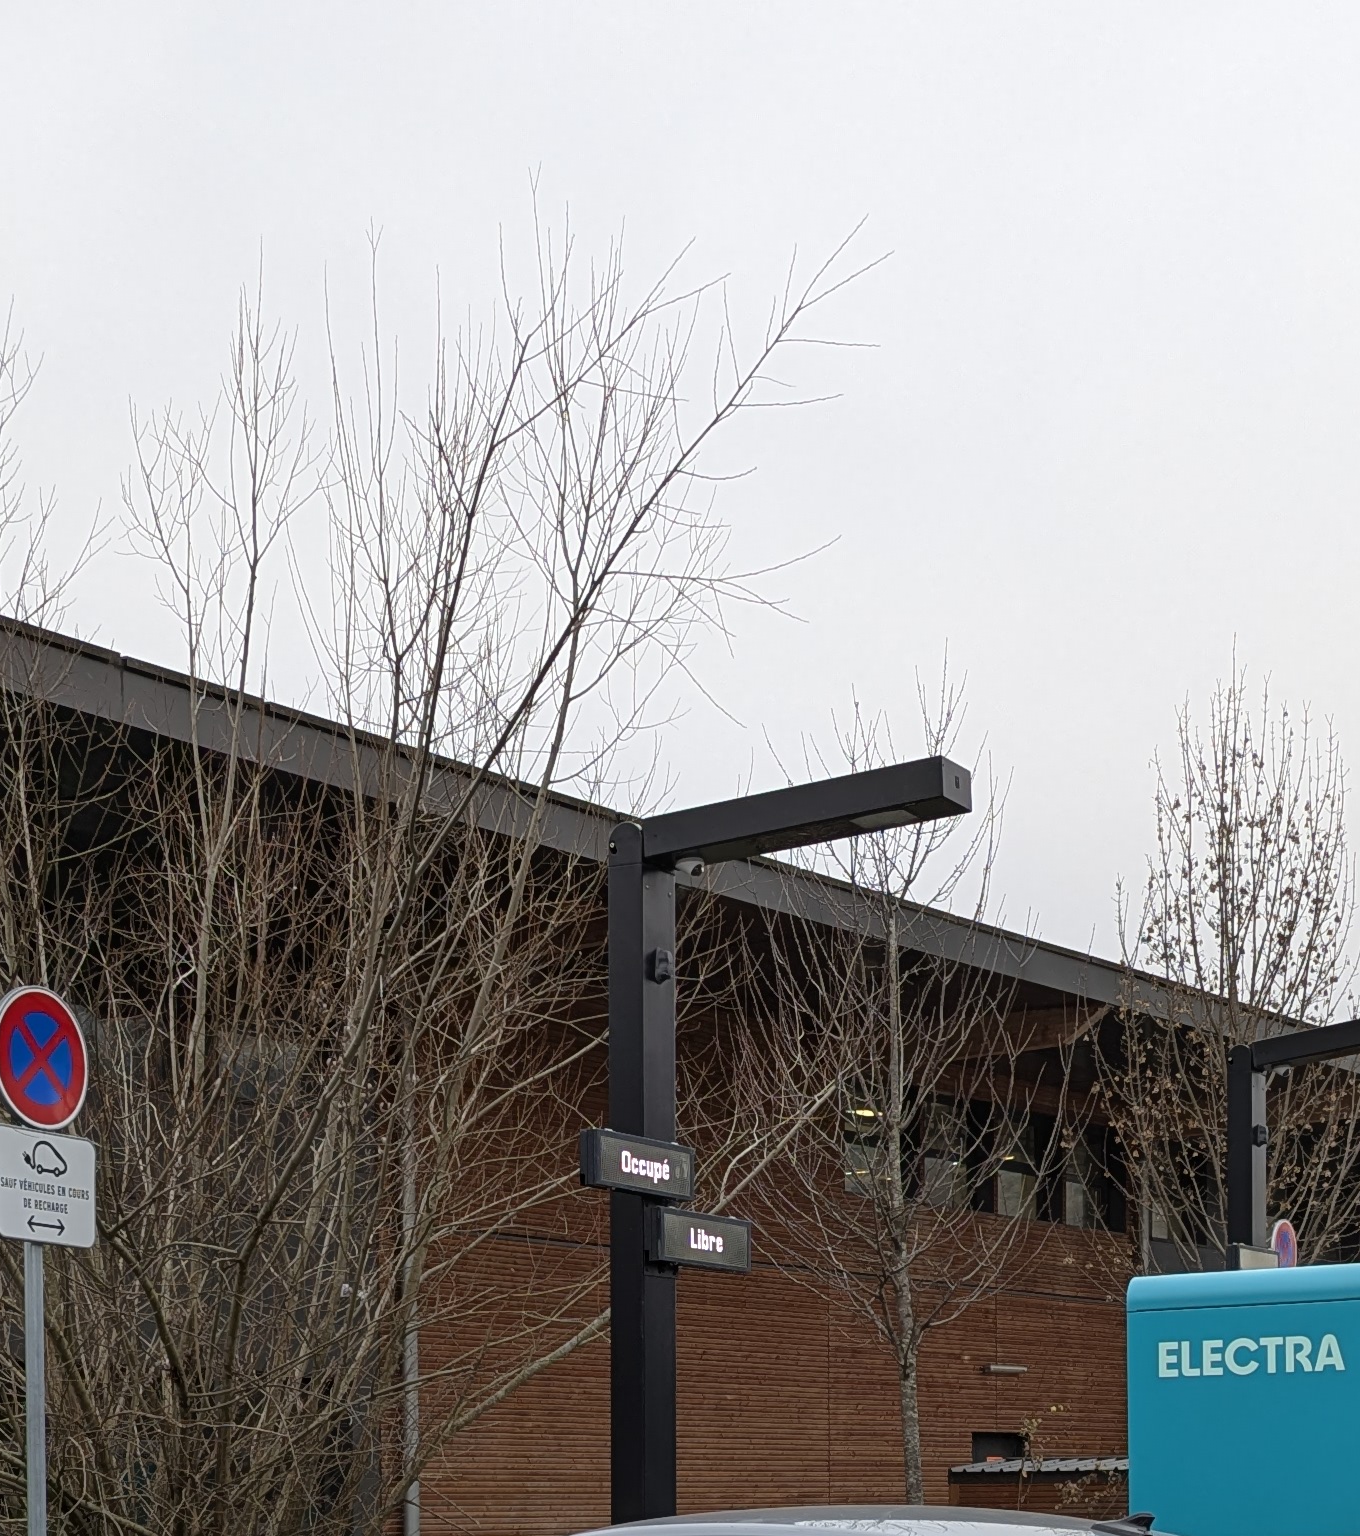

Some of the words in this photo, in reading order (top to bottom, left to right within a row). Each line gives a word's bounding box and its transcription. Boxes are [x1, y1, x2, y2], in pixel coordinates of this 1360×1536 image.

[621, 1150, 670, 1183] Occupé
[0, 1176, 17, 1190] SAUF
[19, 1178, 55, 1195] VÉHICULES
[57, 1184, 66, 1197] EN
[68, 1187, 89, 1200] COURS
[23, 1197, 32, 1208] DE
[34, 1199, 68, 1214] RECHARGE
[690, 1227, 723, 1253] Libre
[1158, 1334, 1346, 1378] ELECTRA
